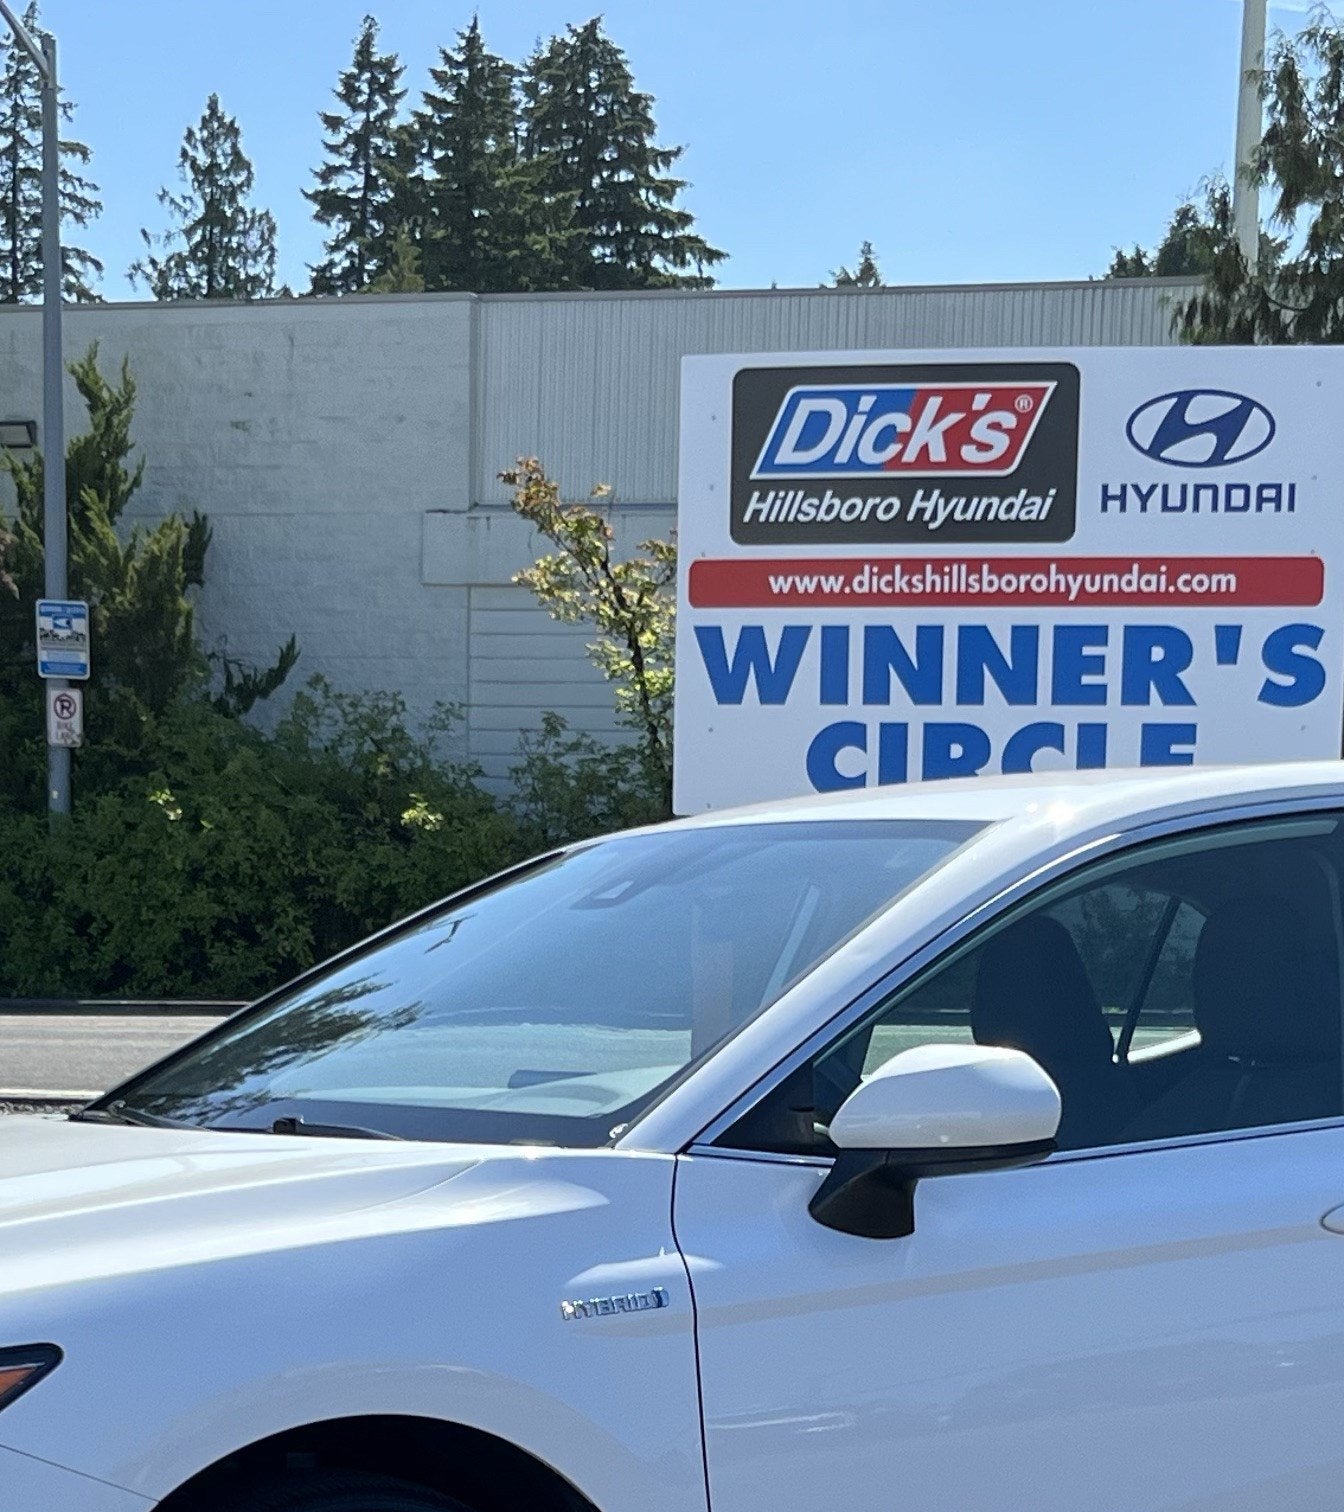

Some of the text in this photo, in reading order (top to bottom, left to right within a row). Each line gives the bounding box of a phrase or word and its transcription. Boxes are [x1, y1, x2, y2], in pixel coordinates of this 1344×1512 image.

[773, 393, 1017, 465] Dick's
[743, 487, 1057, 531] Hillsboro Hyundai
[1100, 482, 1297, 514] HYUNDAI
[767, 564, 1238, 602] www.dickshillsborohyundai.com
[693, 622, 1327, 708] WINNER'S
